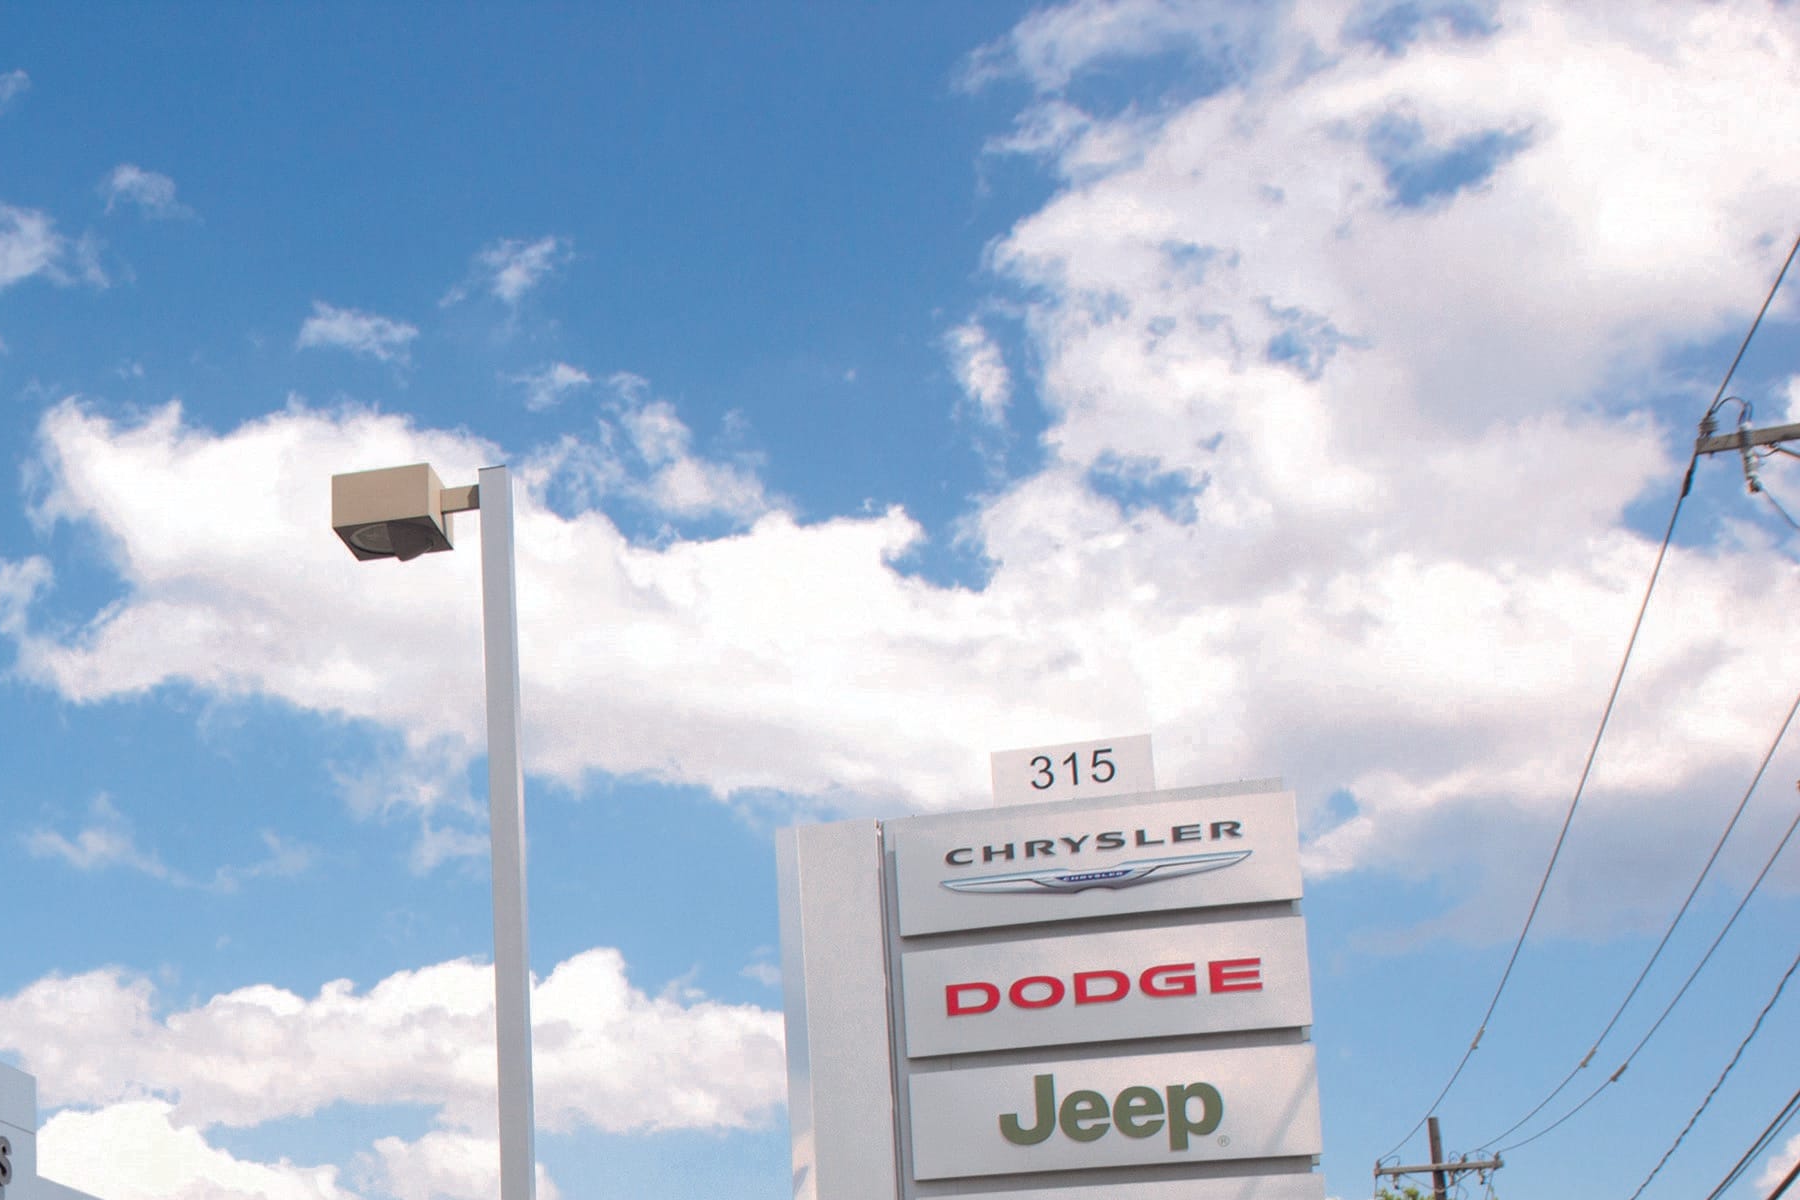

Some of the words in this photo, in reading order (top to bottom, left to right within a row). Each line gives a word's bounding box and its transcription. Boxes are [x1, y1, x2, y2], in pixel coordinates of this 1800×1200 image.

[1030, 748, 1116, 790] 315
[945, 820, 1243, 866] CHRYSLER
[945, 957, 1263, 1017] DODGE
[999, 1074, 1224, 1151] Jeep
